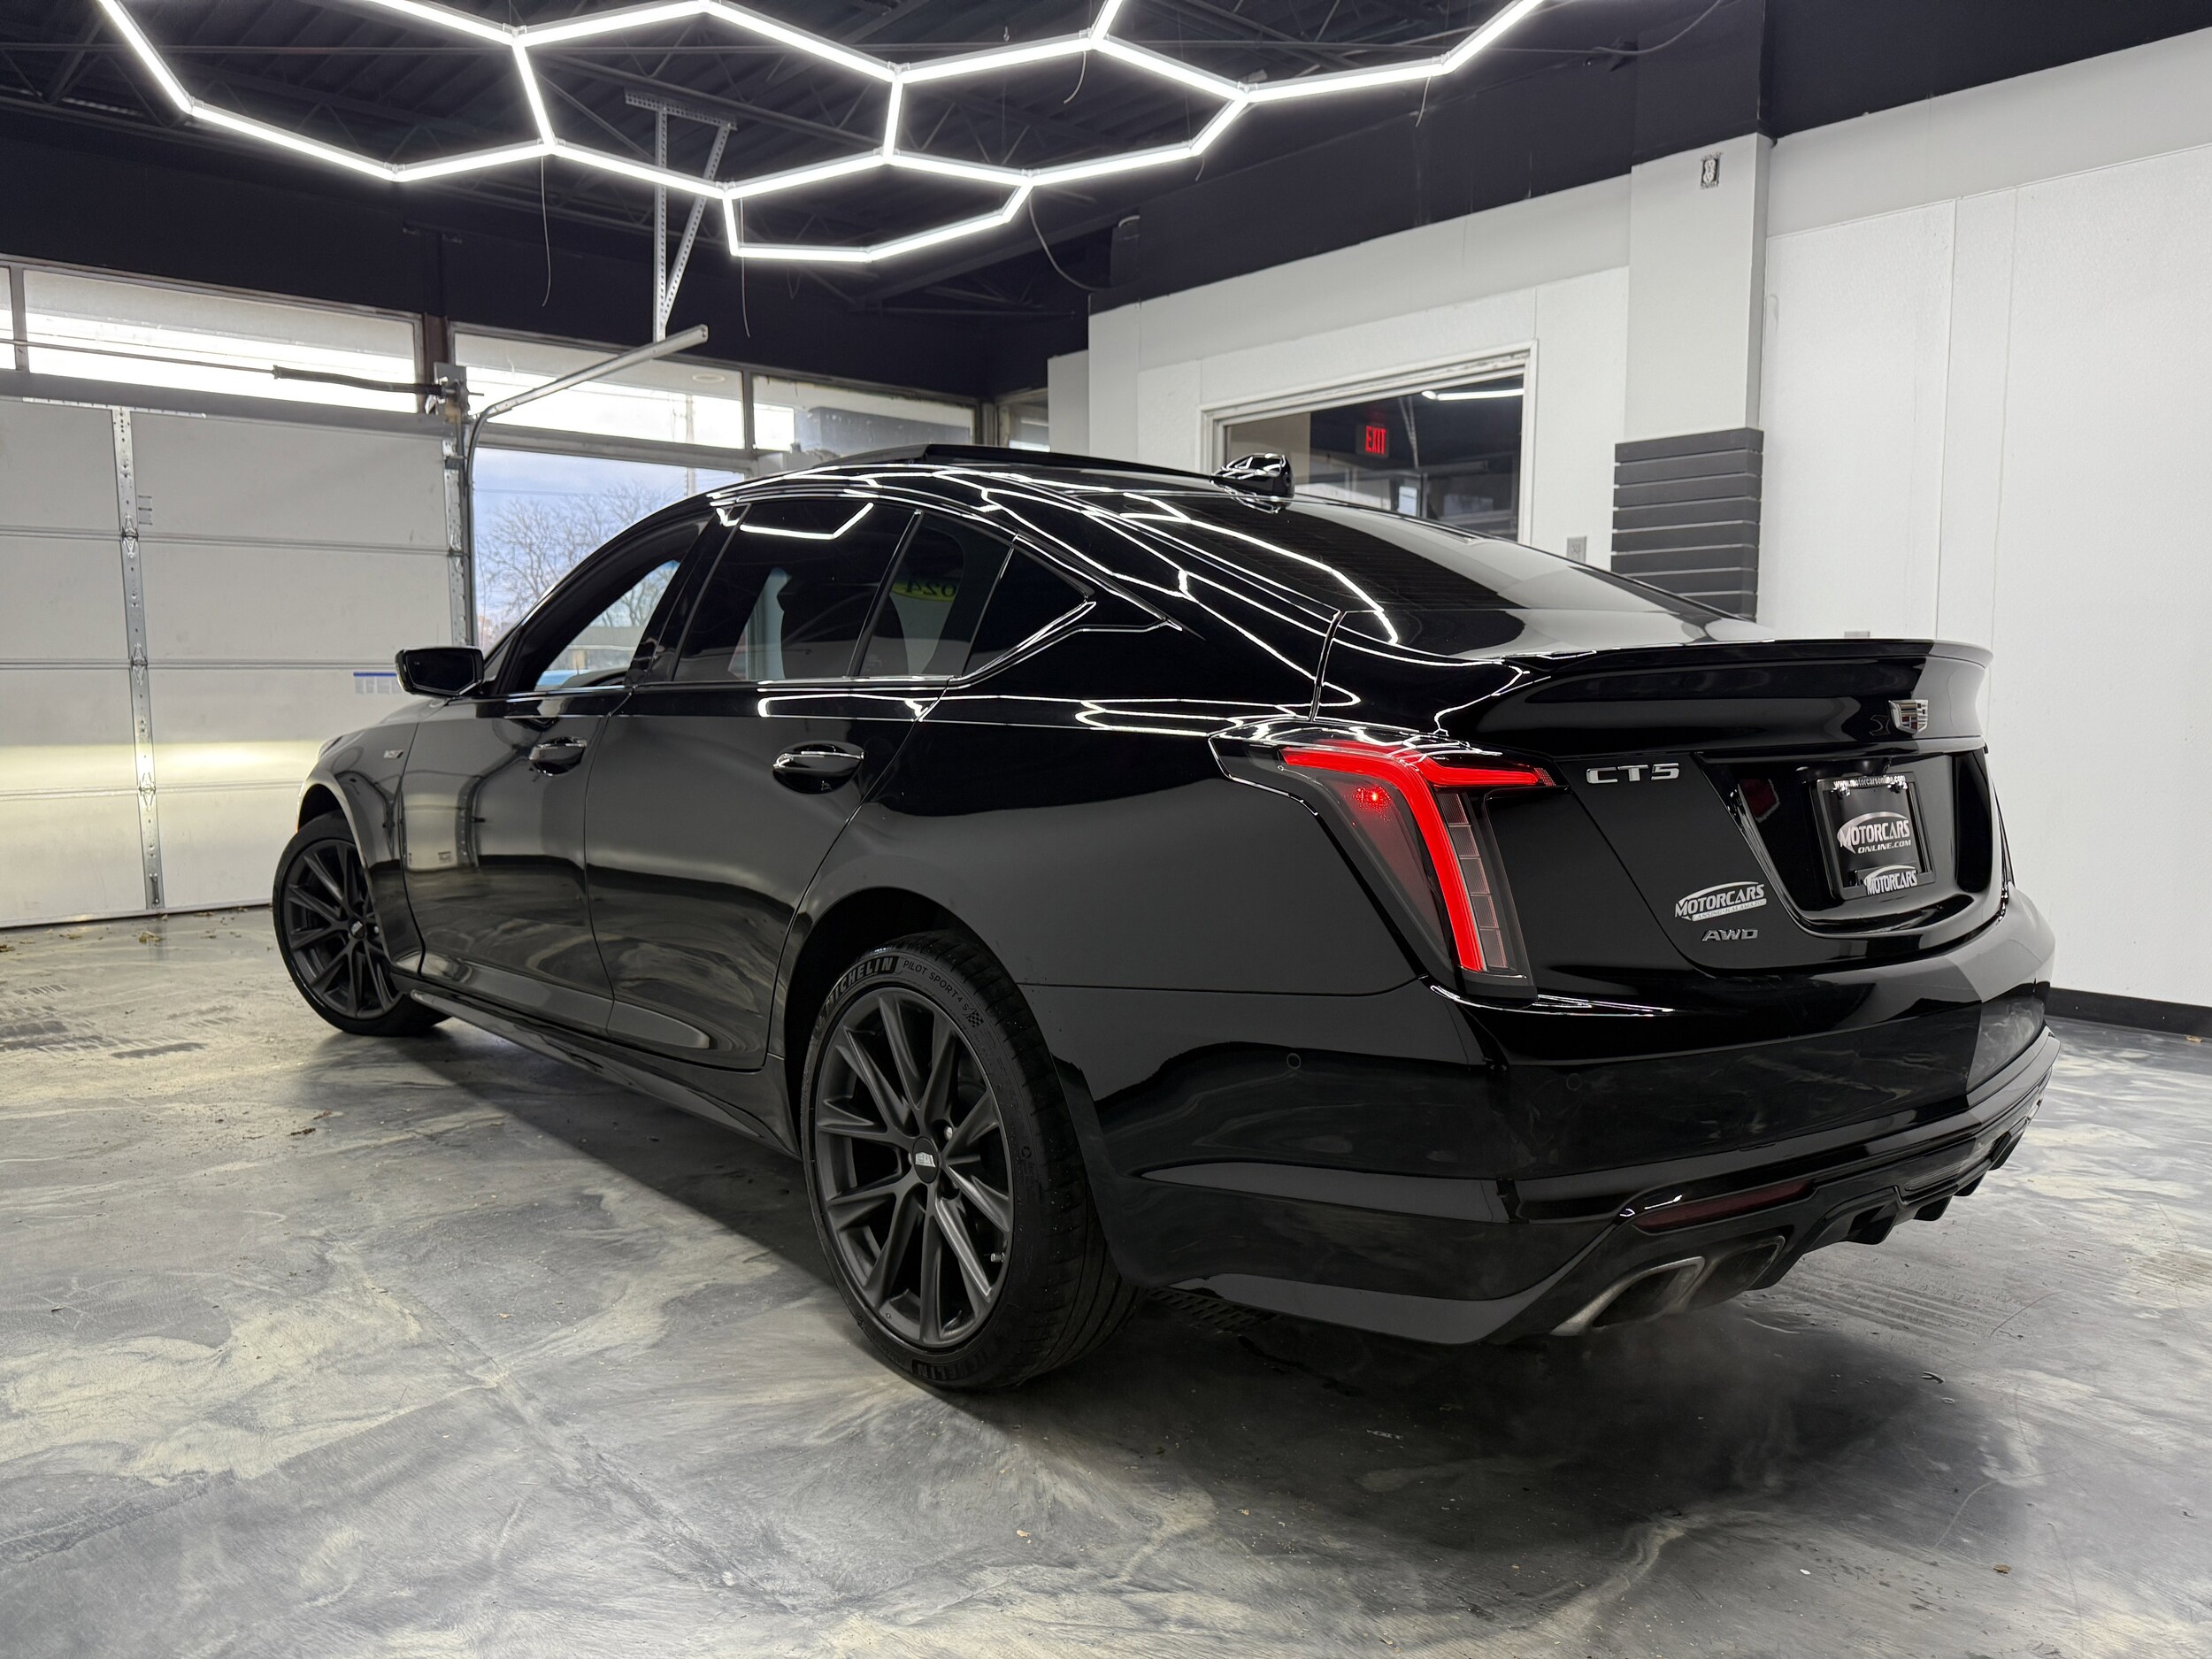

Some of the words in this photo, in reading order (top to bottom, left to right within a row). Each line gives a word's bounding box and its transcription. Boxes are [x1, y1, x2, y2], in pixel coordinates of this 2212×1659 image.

[1365, 426, 1386, 455] EXIT
[1586, 763, 1680, 784] CT5
[1839, 819, 1911, 848] MOTORCARS
[1857, 839, 1912, 855] ONLINE.COM
[1866, 870, 1918, 895] MOTORCARS
[1674, 883, 1765, 918] MOTORCARS
[1701, 929, 1759, 942] AWD
[825, 956, 895, 1015] MICHELIN
[902, 960, 929, 975] PILOT
[928, 972, 958, 997] SPORT
